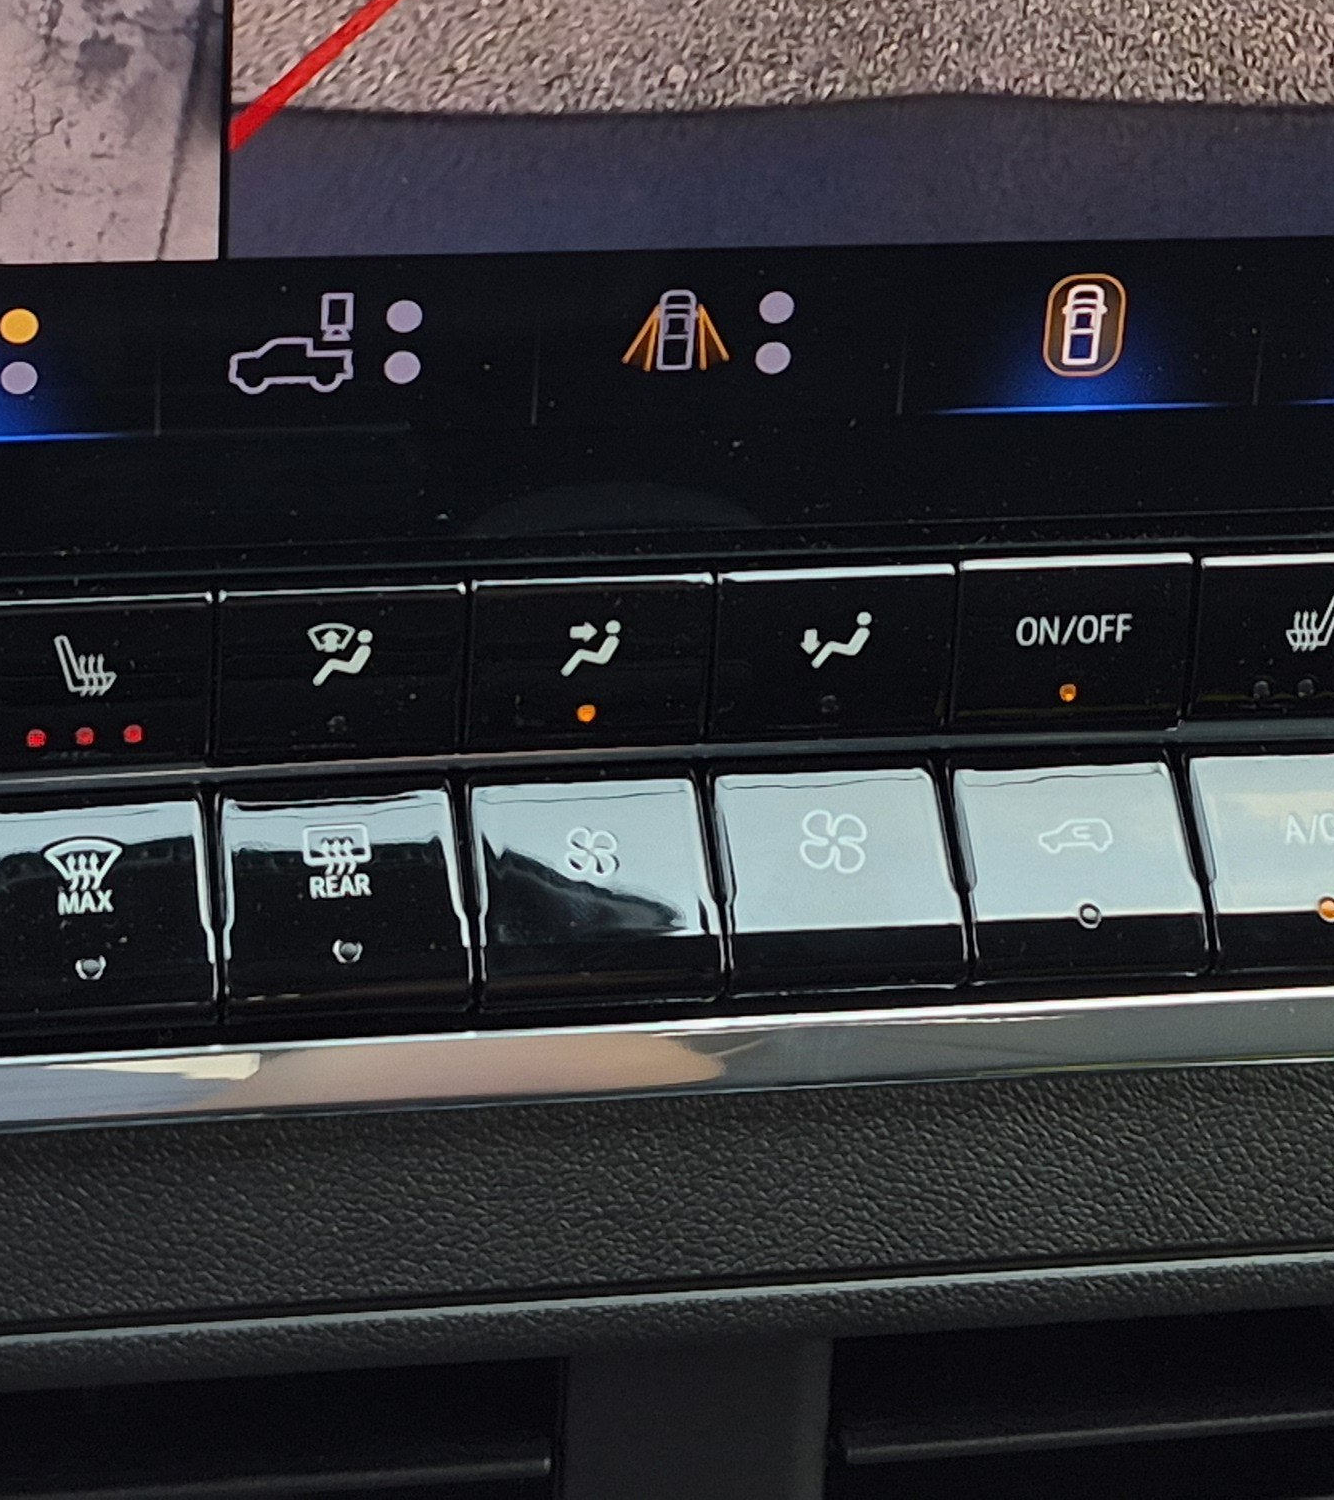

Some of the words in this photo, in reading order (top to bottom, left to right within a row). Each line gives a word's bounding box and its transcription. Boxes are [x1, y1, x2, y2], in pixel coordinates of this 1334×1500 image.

[1015, 612, 1133, 647] ON/OFF
[308, 872, 373, 900] REAR
[57, 888, 115, 916] MAX
